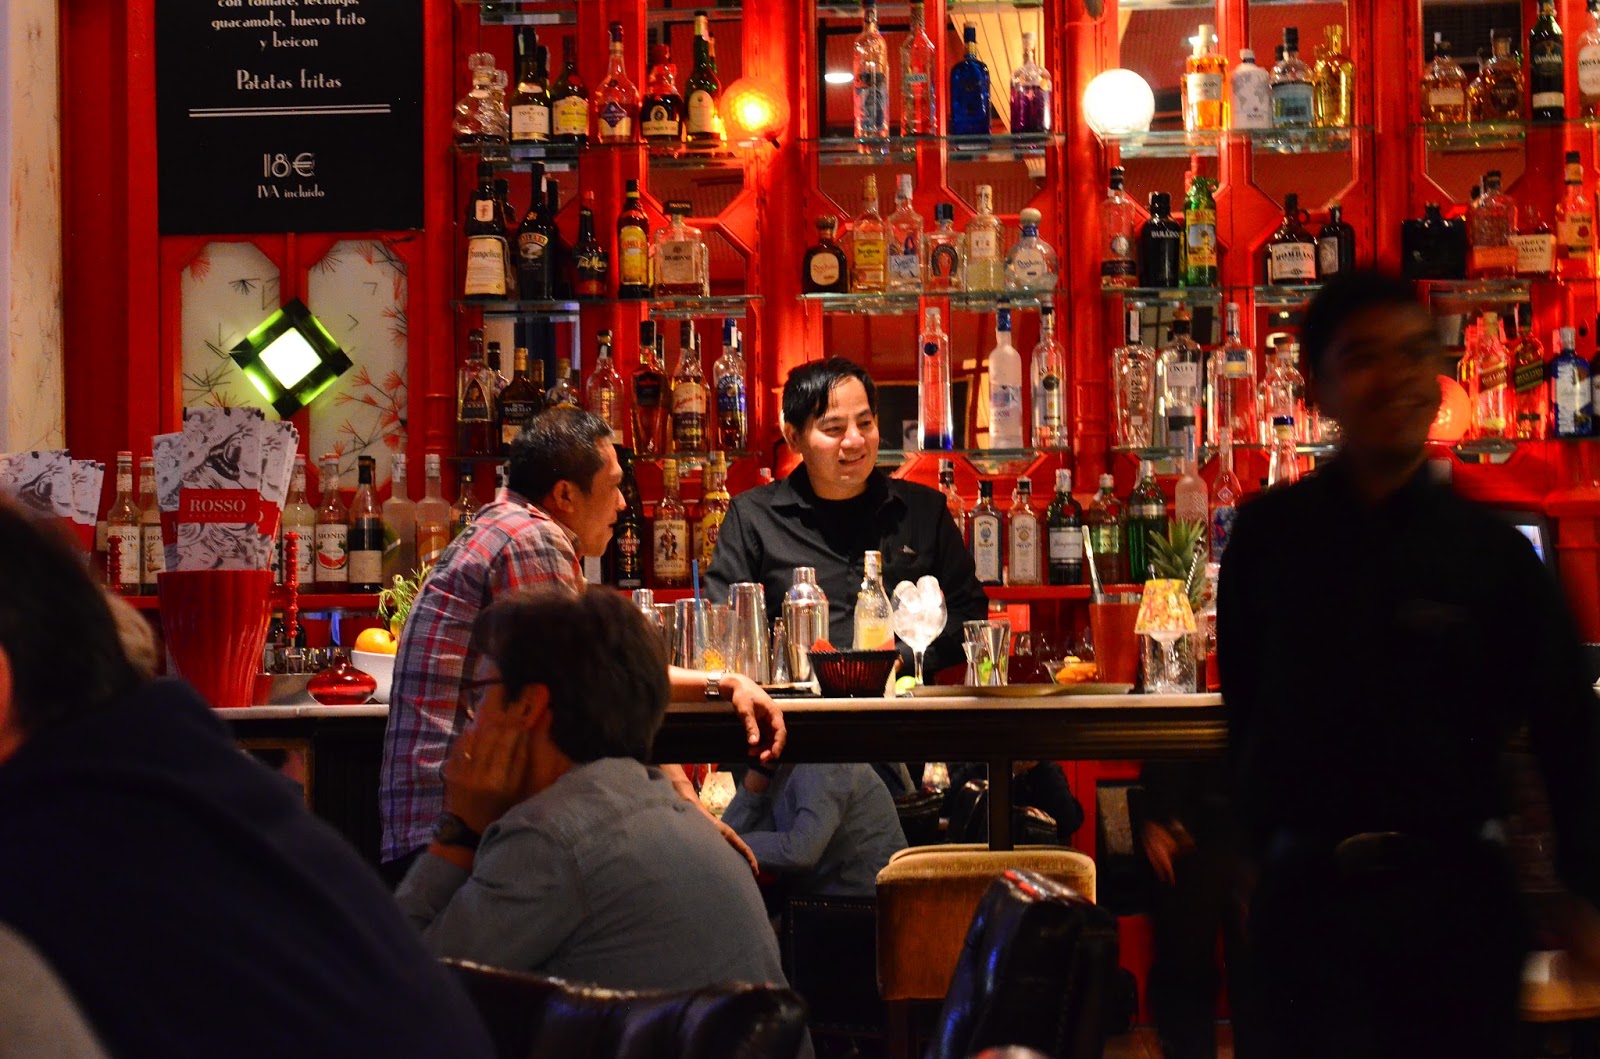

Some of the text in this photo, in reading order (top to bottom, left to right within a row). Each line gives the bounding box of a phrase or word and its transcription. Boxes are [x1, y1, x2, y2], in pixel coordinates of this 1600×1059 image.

[211, 9, 366, 31] guacamole, huevo frito
[260, 31, 319, 51] y beicon
[237, 68, 342, 90] Patatas fritas
[263, 152, 315, 178] 18€
[257, 184, 325, 198] IVA incluido
[190, 499, 247, 513] ROSSO
[317, 532, 346, 540] MONIN
